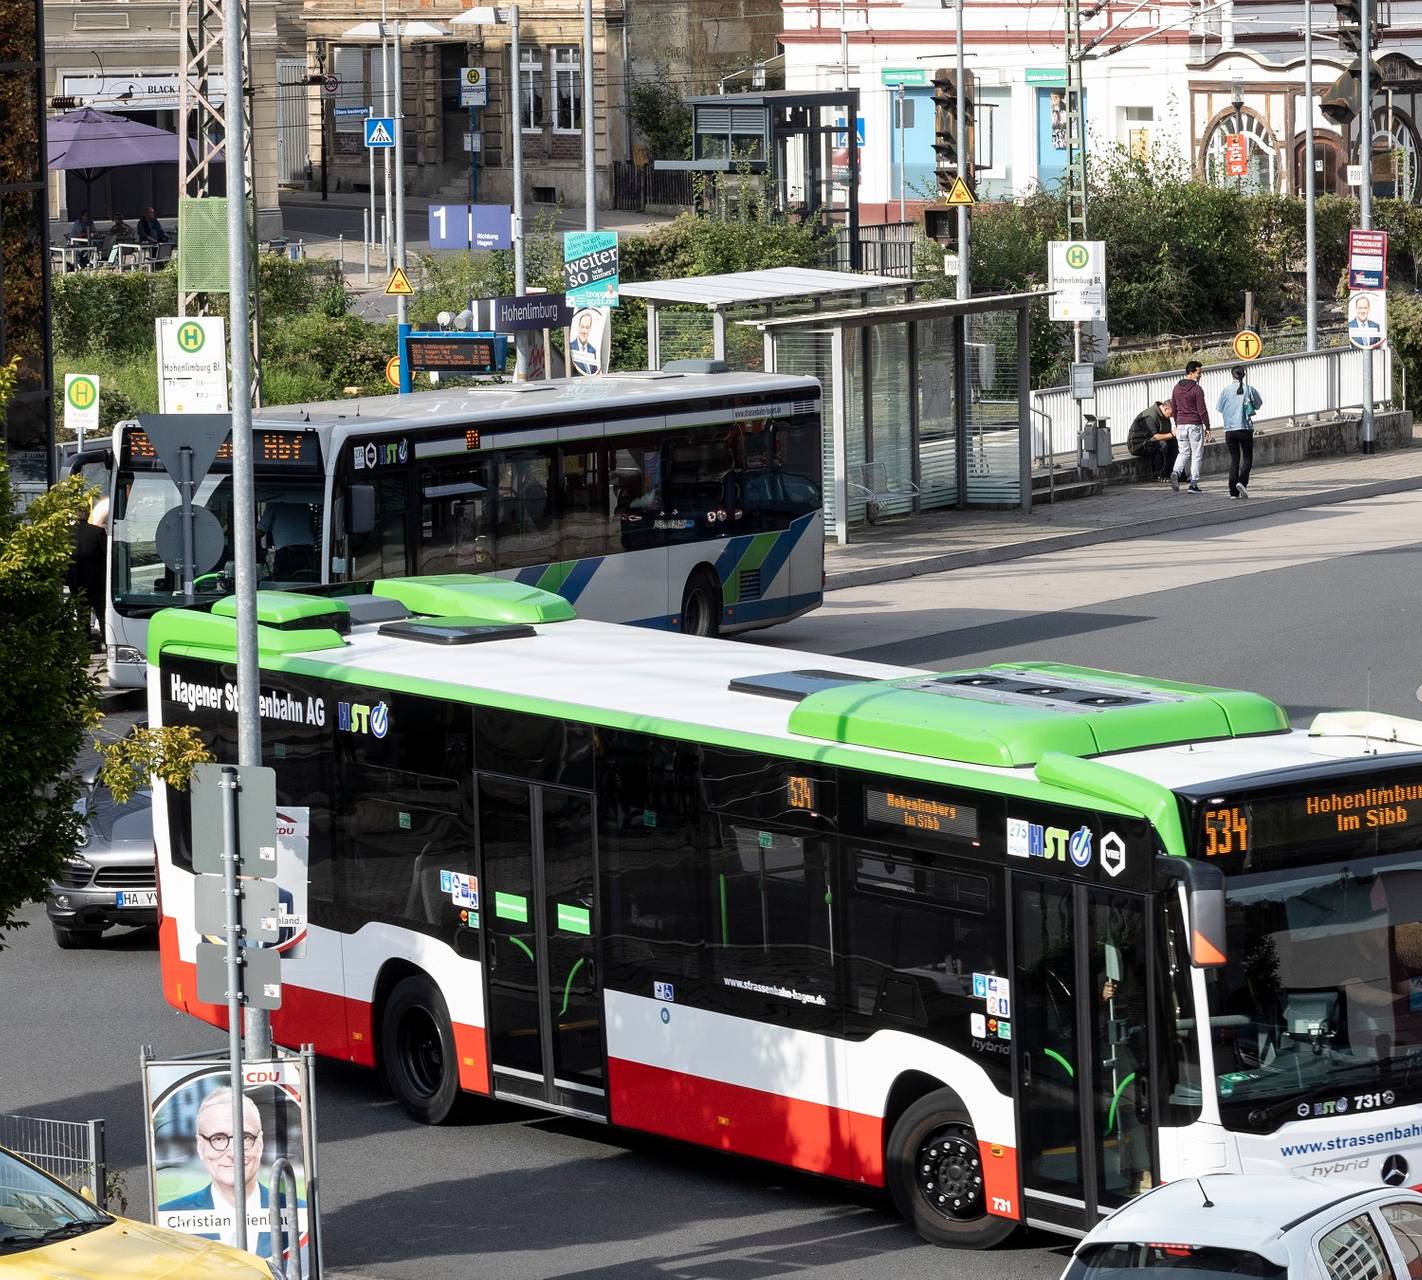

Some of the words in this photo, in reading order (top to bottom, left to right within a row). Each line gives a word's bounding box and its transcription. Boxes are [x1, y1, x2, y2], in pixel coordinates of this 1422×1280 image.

[147, 85, 176, 94] BLACK
[433, 206, 446, 239] 1
[477, 233, 499, 241] Richtung
[582, 244, 598, 253] dann
[565, 248, 617, 275] weiter
[569, 272, 589, 288] so
[592, 267, 604, 275] wie
[592, 268, 616, 281] immer?
[1054, 277, 1093, 286] Hohenlimburg
[501, 303, 558, 322] Hohenlimburg
[164, 362, 211, 374] Hohenlimburg
[264, 435, 303, 460] Hbf
[170, 673, 223, 712] Hagener
[225, 682, 303, 723] Stenbahn
[306, 696, 325, 727] AG
[338, 701, 370, 734] HST
[788, 776, 815, 809] 534
[886, 793, 958, 820] Hohenlimburg
[917, 814, 940, 830] Sibb
[1336, 814, 1360, 832] Im
[1366, 806, 1408, 827] Sibb
[1205, 808, 1248, 856] 534
[1029, 823, 1070, 862] HST
[124, 893, 139, 904] HA
[723, 977, 827, 1006] www.strassenbahn-hagen.de
[971, 1038, 1010, 1055] hybrid
[246, 1072, 280, 1083] CDU
[1314, 1101, 1336, 1116] HST
[1354, 1093, 1381, 1110] 731
[1311, 1157, 1370, 1178] hybrid
[992, 1196, 1011, 1213] 731
[168, 1212, 231, 1228] Christian
